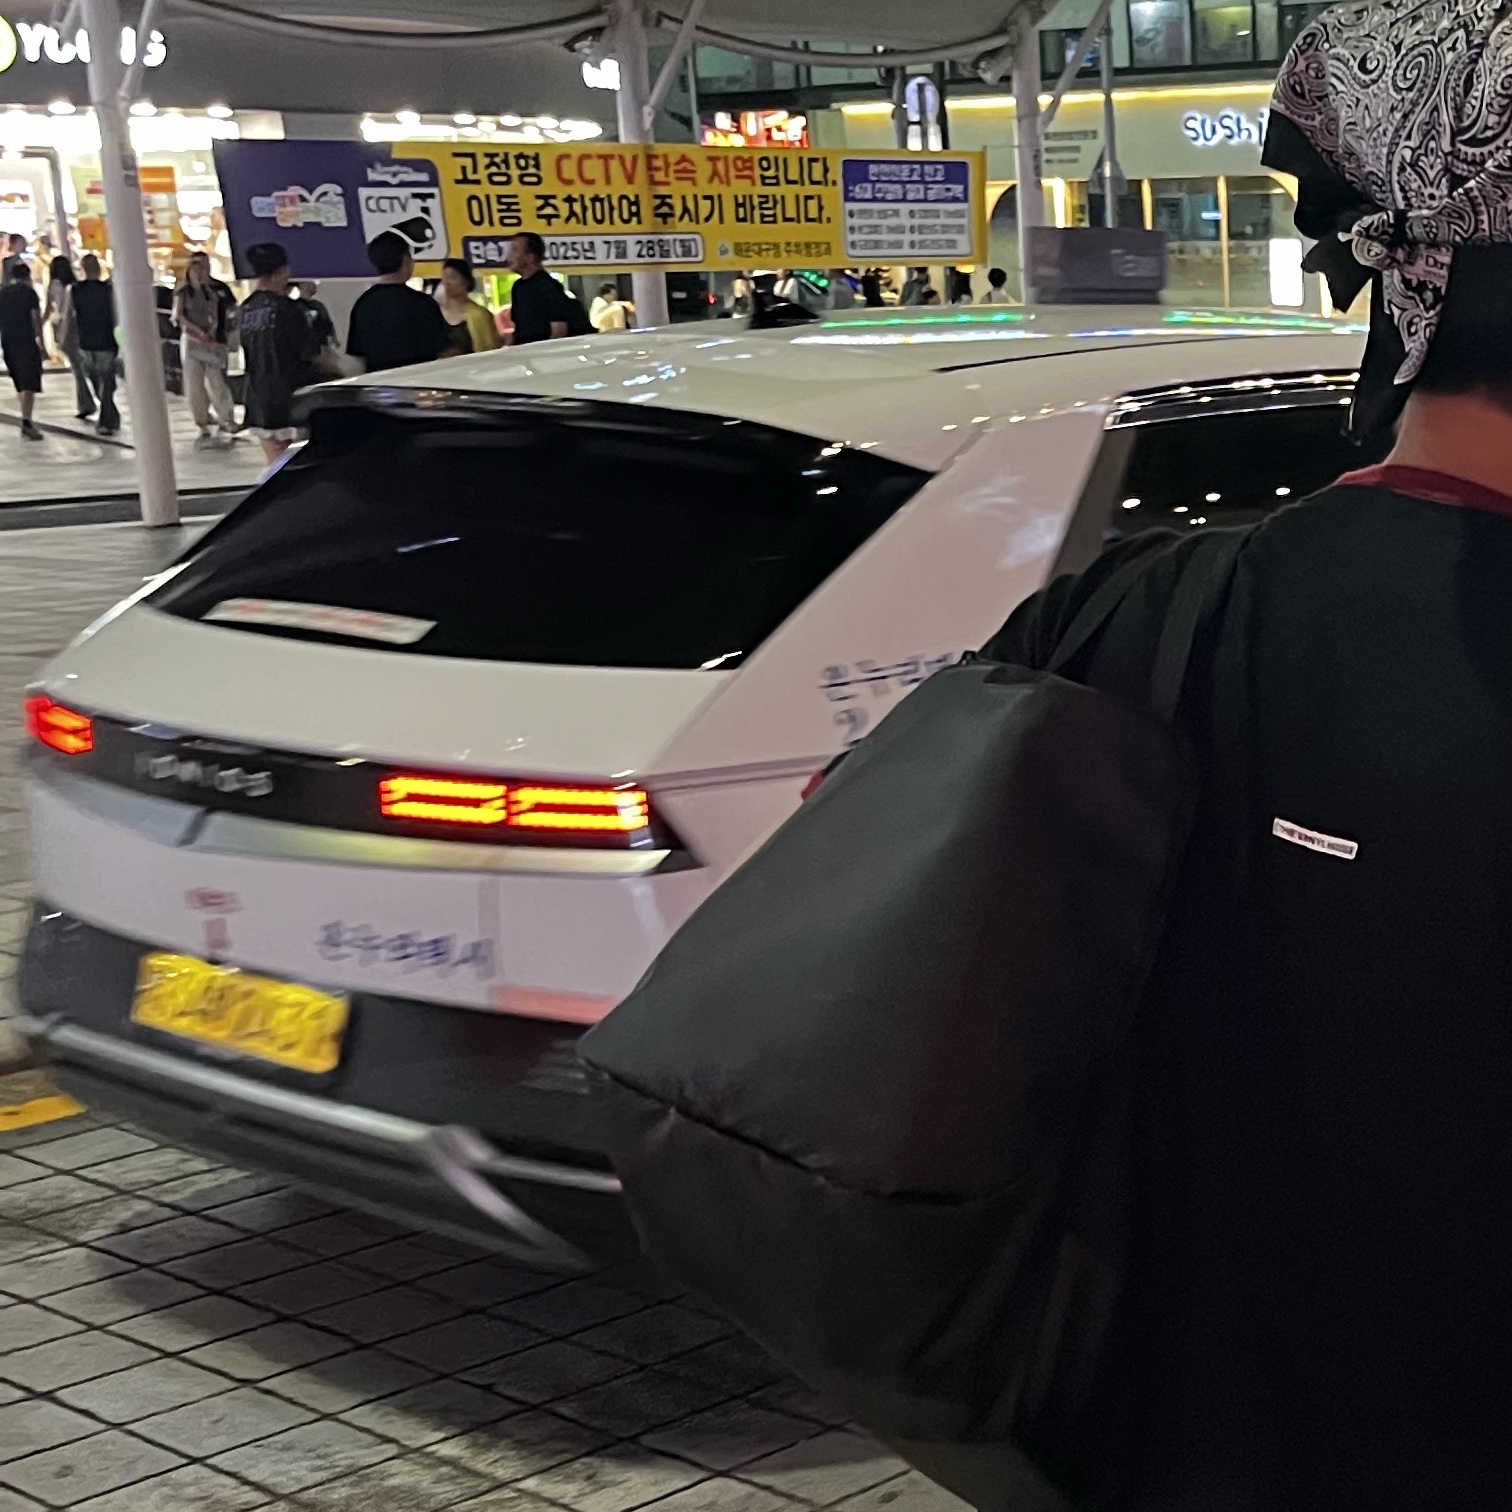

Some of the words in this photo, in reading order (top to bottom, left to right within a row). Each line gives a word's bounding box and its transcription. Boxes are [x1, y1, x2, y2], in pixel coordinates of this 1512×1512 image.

[451, 151, 543, 186] 고정형
[555, 153, 640, 186] CCTV
[647, 153, 698, 187] 단속
[706, 155, 837, 187] 지역입니다.
[365, 195, 410, 213] CCTV
[466, 194, 523, 227] 이동
[534, 193, 643, 226] 주차하여
[652, 193, 725, 225] 주시기
[734, 193, 832, 225] 바랍니다.
